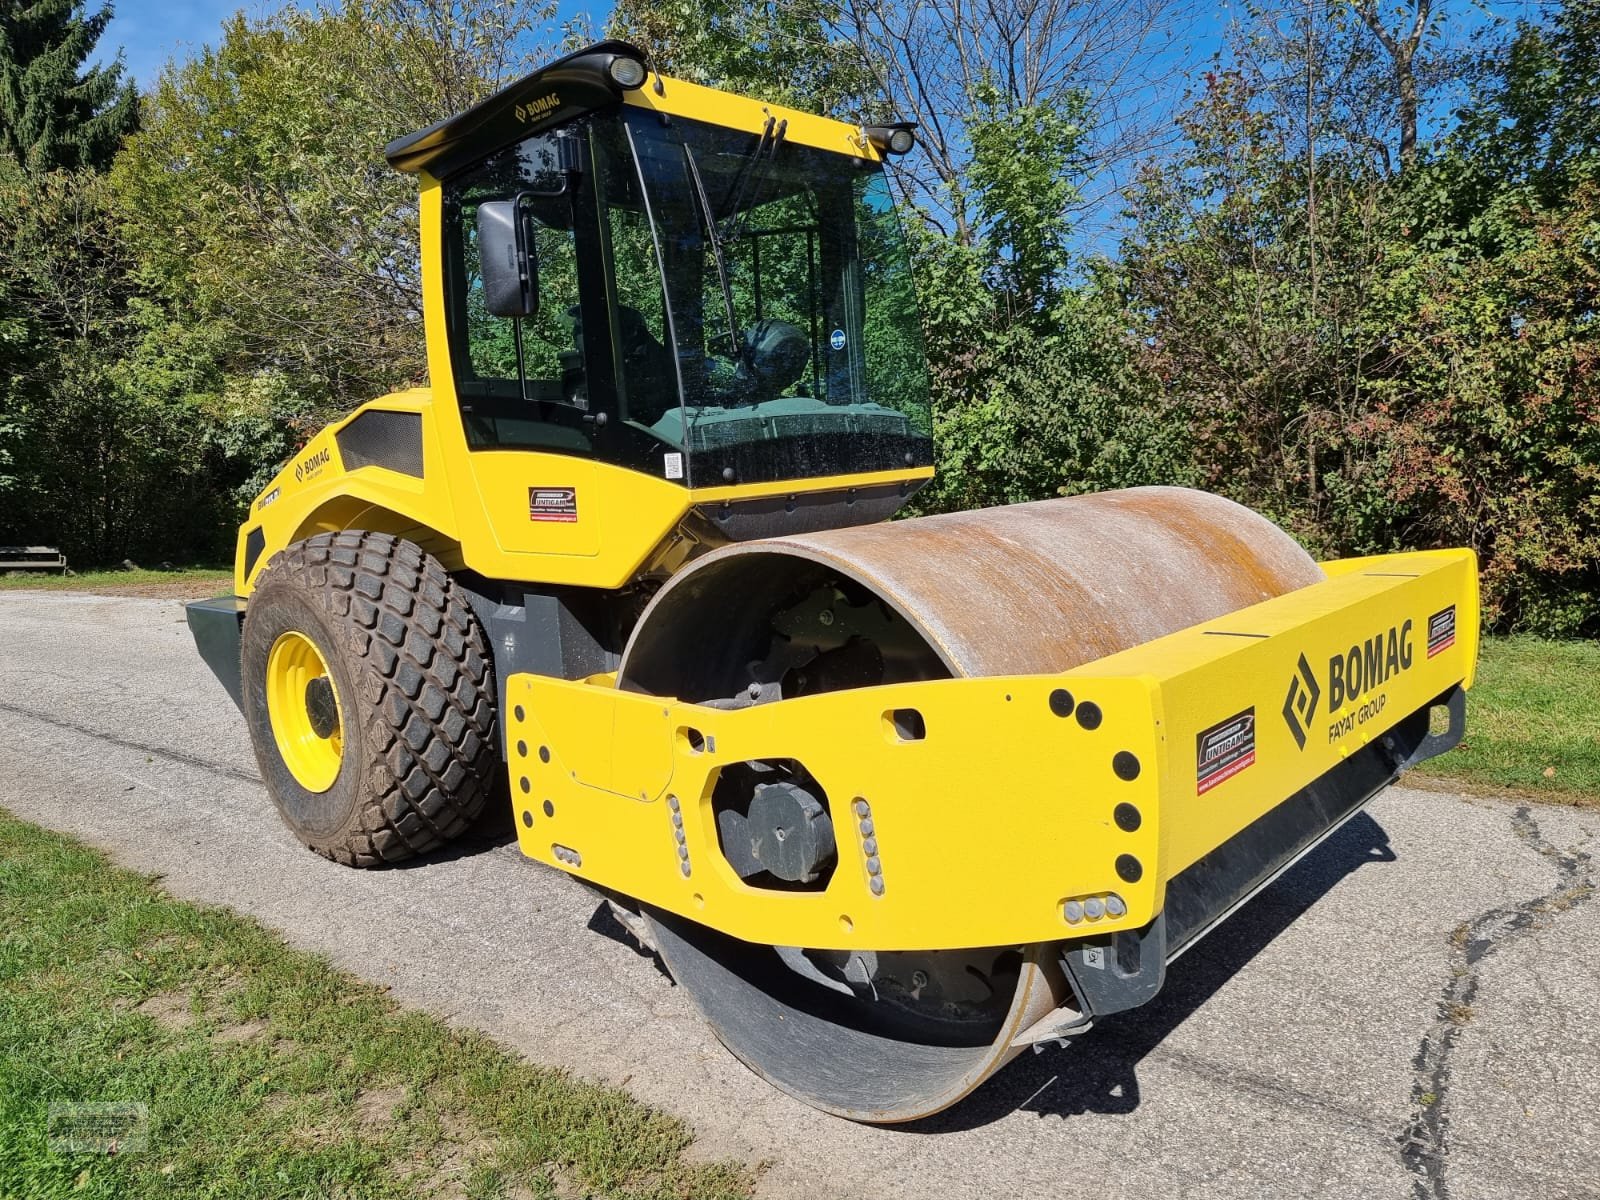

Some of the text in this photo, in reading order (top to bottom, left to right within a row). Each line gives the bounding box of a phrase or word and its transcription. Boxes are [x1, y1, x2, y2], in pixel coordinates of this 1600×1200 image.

[526, 92, 560, 116] BOMAG
[304, 448, 330, 474] BOMAG
[1329, 619, 1412, 714] BOMAG
[1328, 694, 1386, 744] FAYAT GROUP
